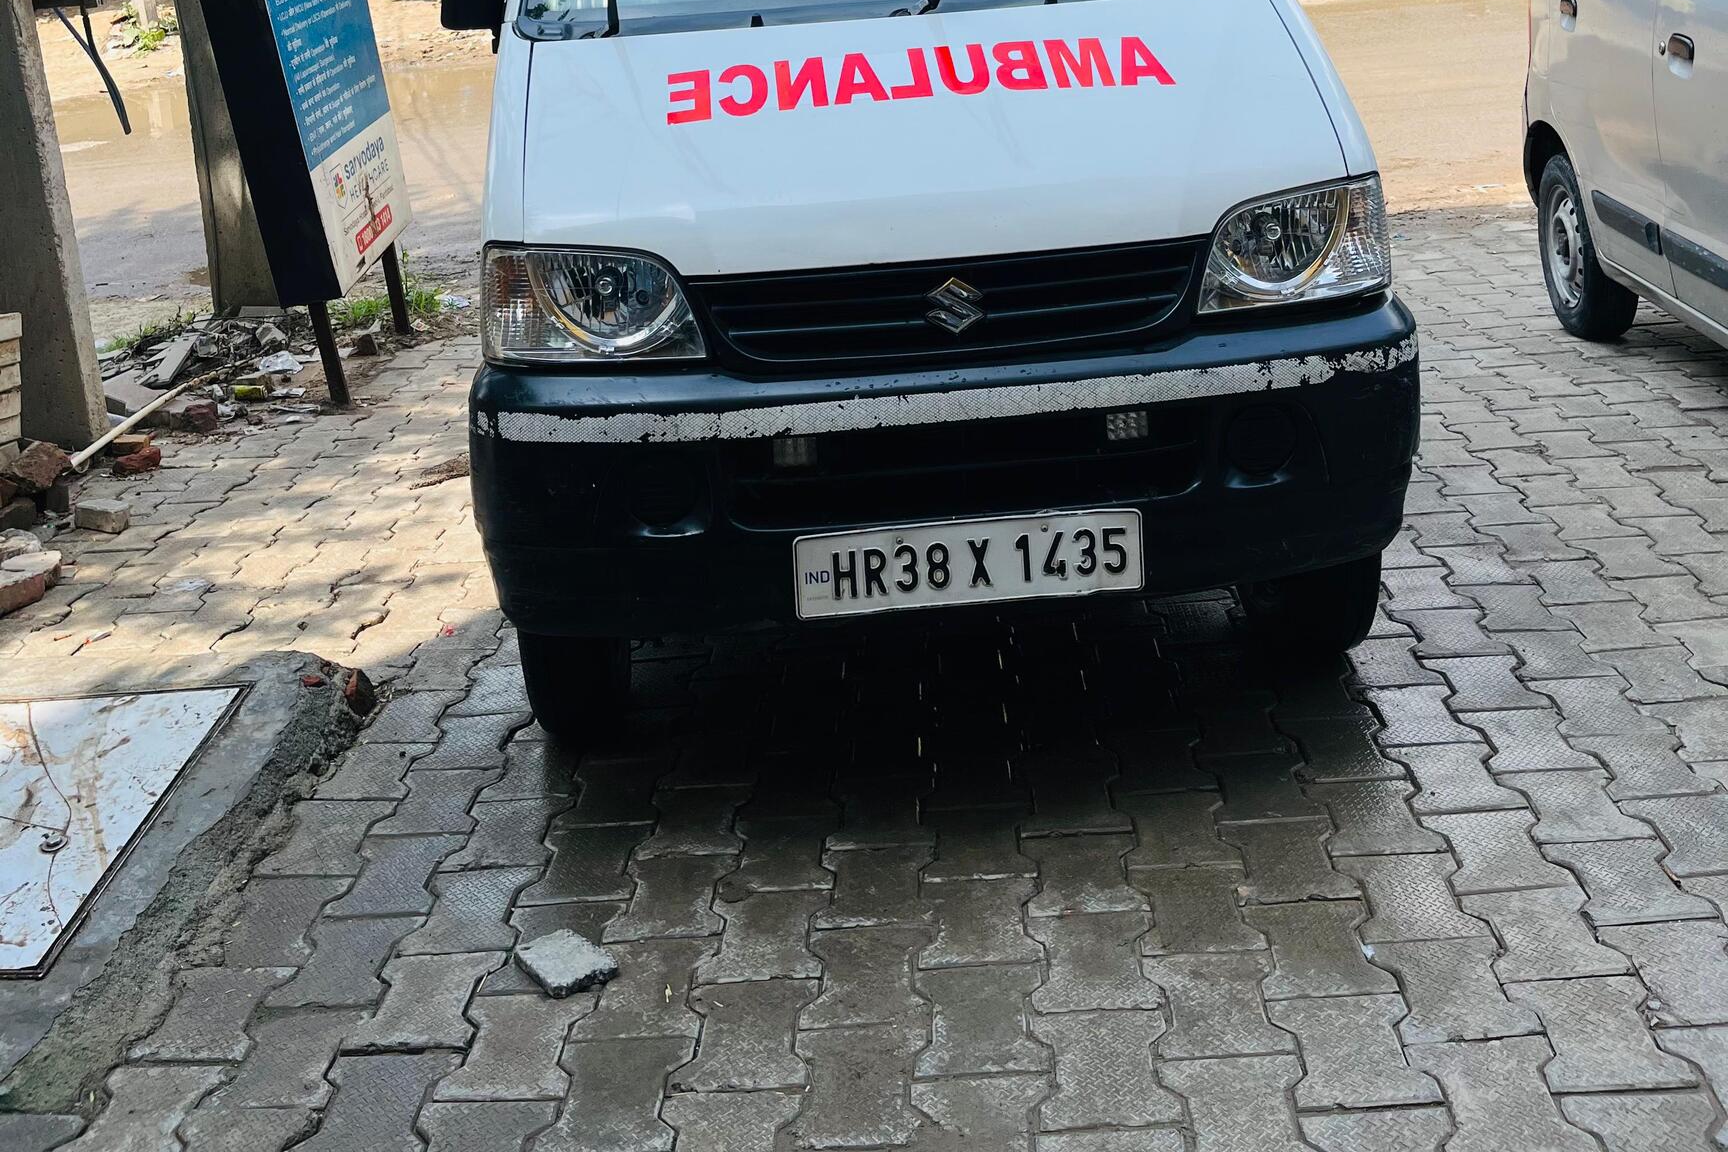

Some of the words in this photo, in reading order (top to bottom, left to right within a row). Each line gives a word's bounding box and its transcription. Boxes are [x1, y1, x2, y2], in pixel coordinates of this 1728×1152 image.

[344, 136, 385, 180] sarvodaya
[804, 570, 830, 585] IND
[832, 543, 950, 598] HR38
[967, 538, 993, 586] X
[1013, 527, 1127, 582] 1435
